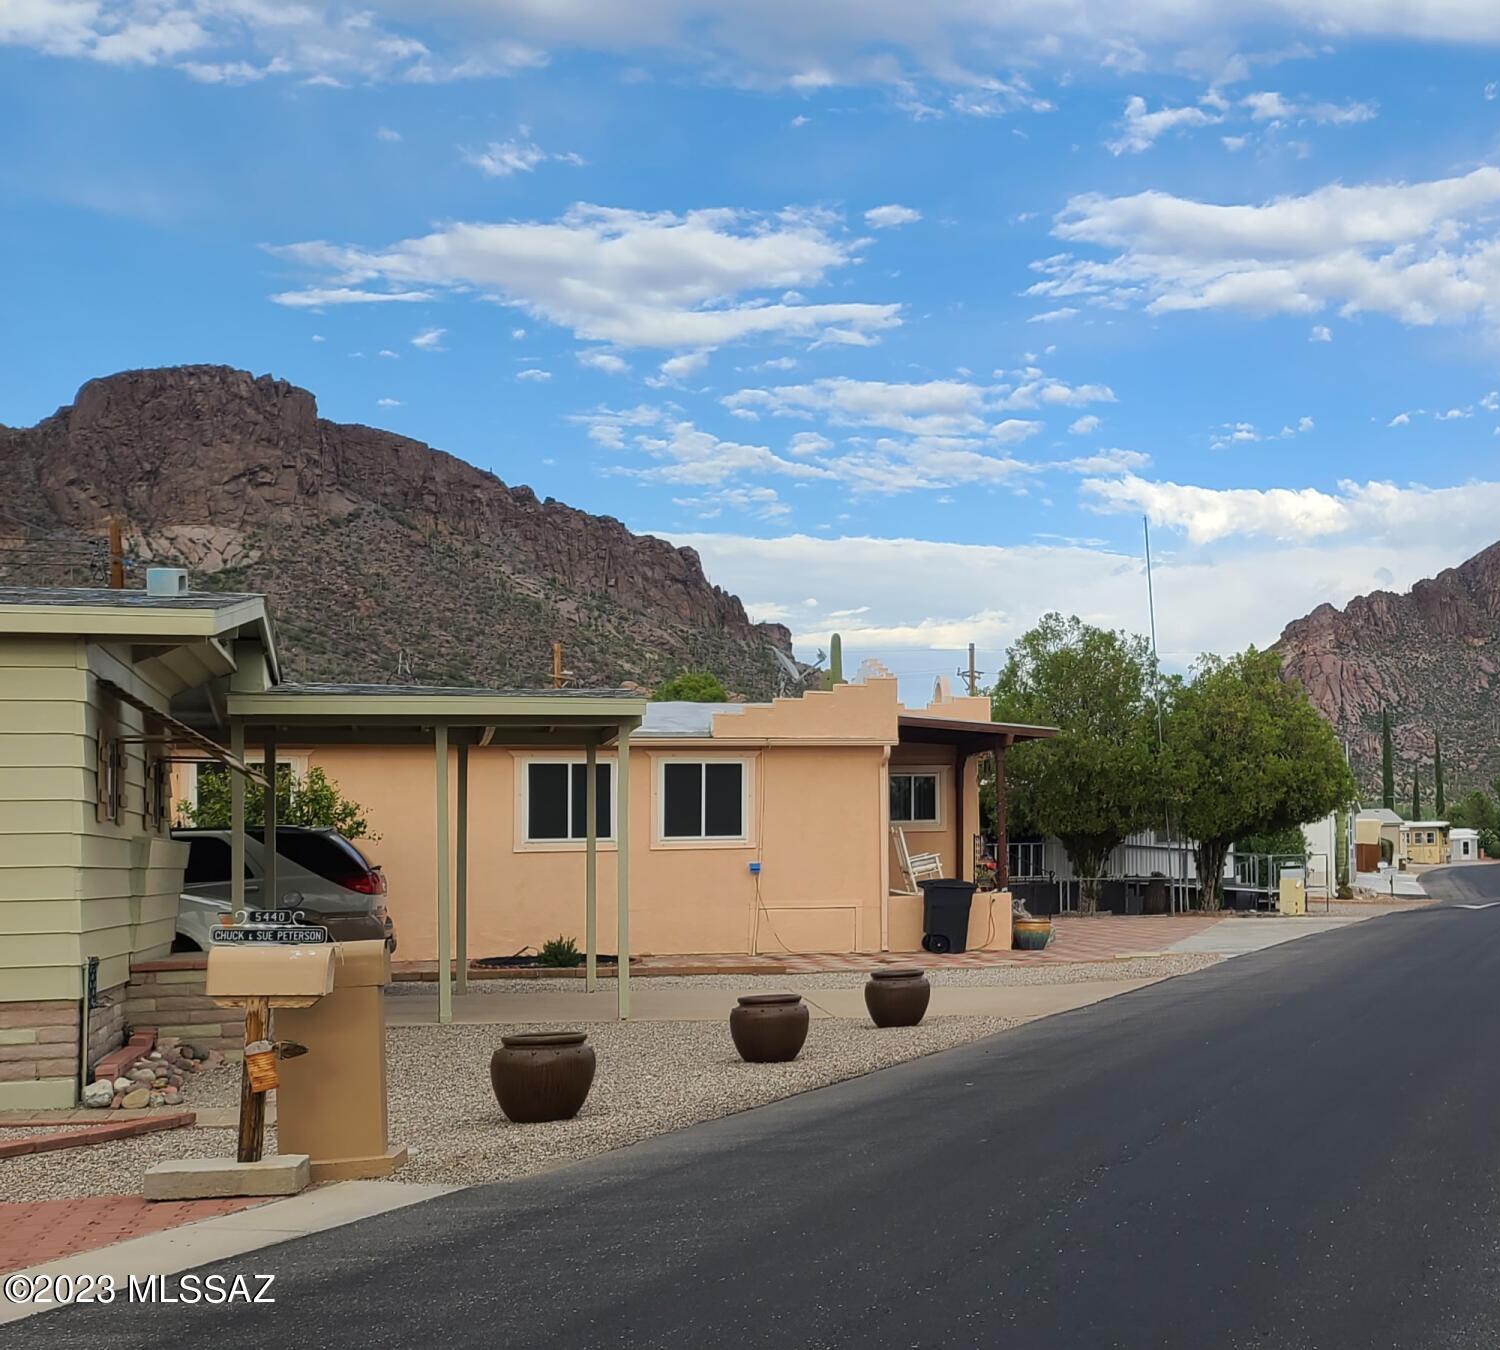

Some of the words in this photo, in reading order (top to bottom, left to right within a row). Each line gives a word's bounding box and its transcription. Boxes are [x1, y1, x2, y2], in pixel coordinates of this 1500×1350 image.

[255, 912, 285, 922] 5440
[214, 930, 244, 940] CHUCK
[256, 931, 273, 940] SUE
[277, 930, 321, 941] PETERSON
